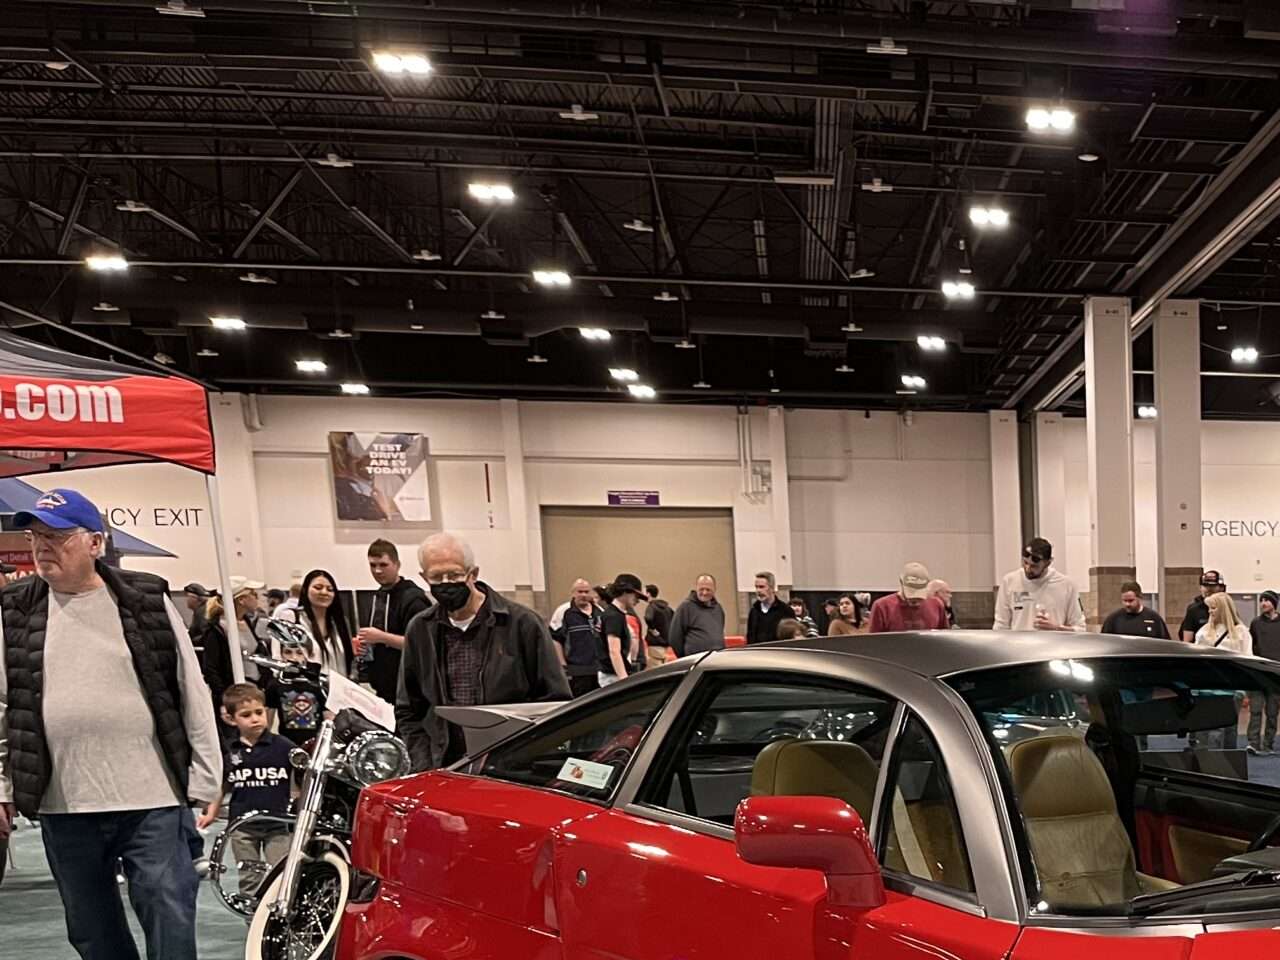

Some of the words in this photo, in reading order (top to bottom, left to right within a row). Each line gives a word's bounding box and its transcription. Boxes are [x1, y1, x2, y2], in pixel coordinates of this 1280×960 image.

[0, 383, 125, 423] .com
[372, 444, 402, 452] TEST
[106, 508, 142, 526] CY
[154, 508, 203, 526] EXIT
[255, 767, 288, 779] USA
